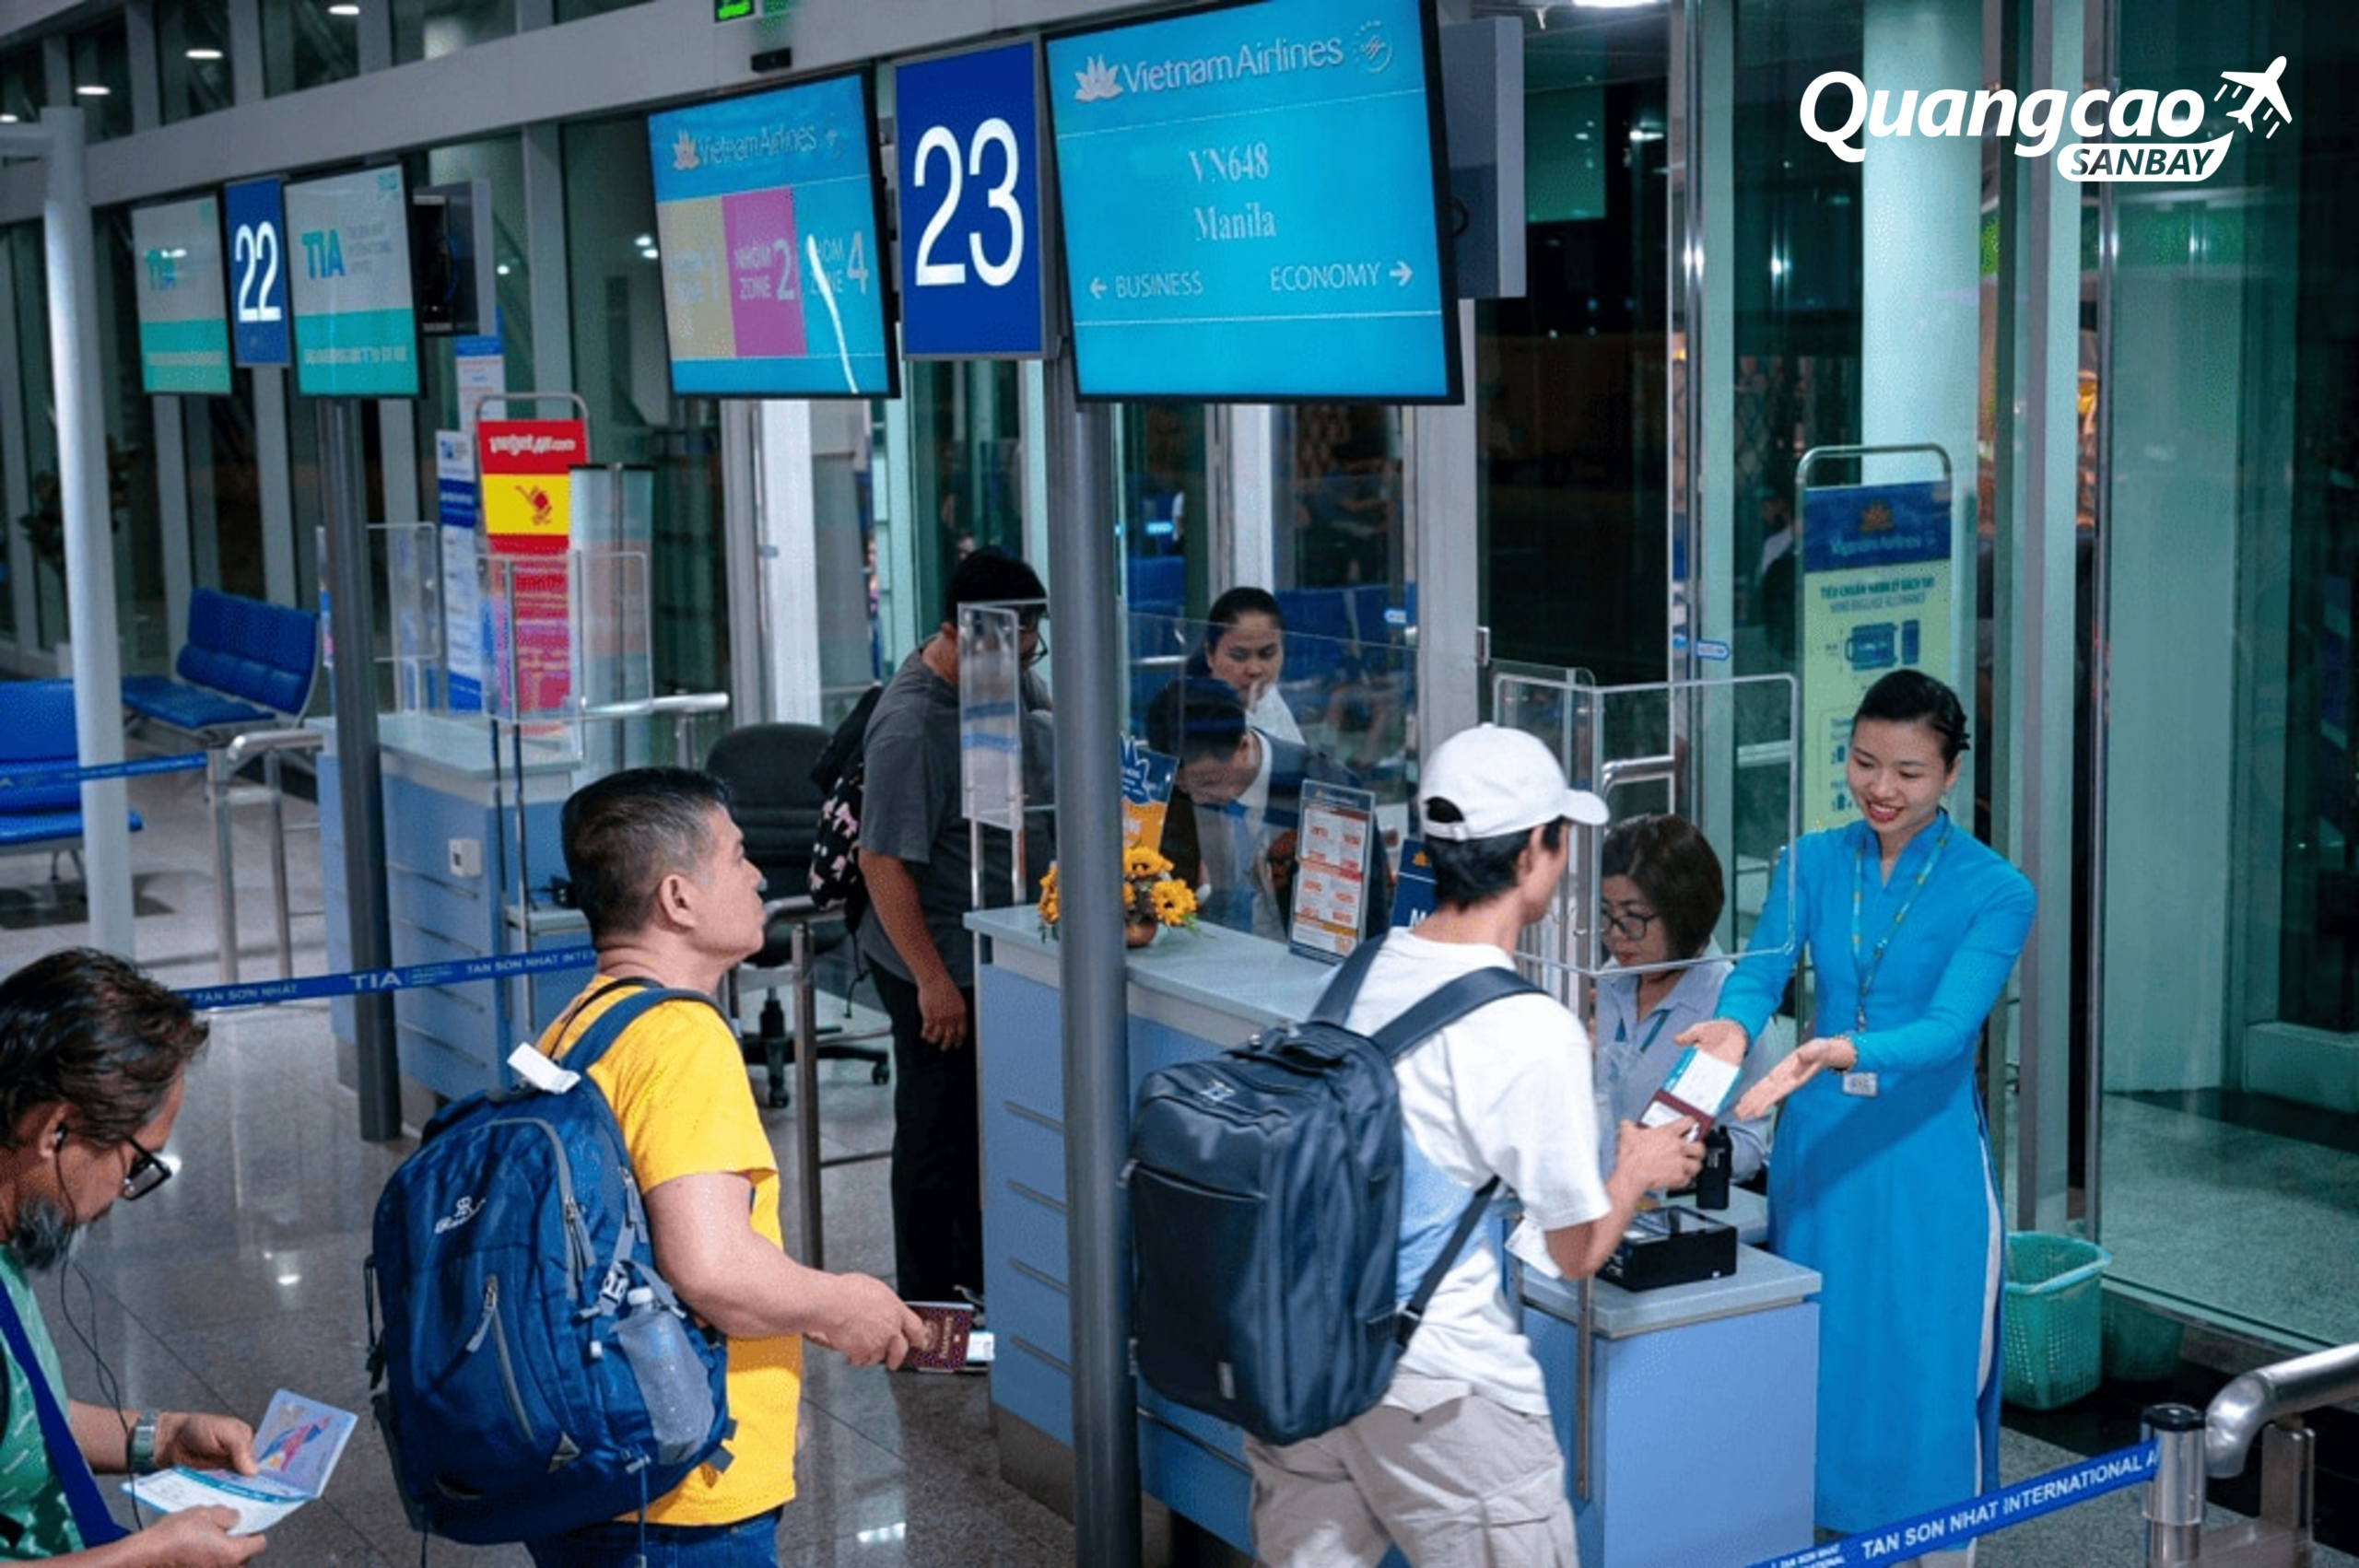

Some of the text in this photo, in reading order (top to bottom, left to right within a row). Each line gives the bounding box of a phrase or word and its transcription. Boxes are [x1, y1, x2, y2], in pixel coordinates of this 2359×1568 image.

[1121, 36, 1344, 93] Vietnam Airlines
[699, 126, 816, 165] Vietnam Airlines
[1189, 142, 1269, 184] VN648
[914, 117, 1025, 287] 23
[1194, 202, 1276, 242] Manila
[235, 221, 282, 322] 22
[301, 228, 346, 280] TIA
[773, 239, 795, 300] 2
[847, 231, 869, 295] 4
[1270, 262, 1380, 291] ECONOMY
[1115, 271, 1203, 298] BUSINESS
[348, 971, 403, 991] TIA
[1861, 1532, 1899, 1560] TAN
[1905, 1518, 1944, 1546] SON
[1950, 1502, 1999, 1532] NHAT
[2001, 1455, 2142, 1515] INTERNATIONAL
